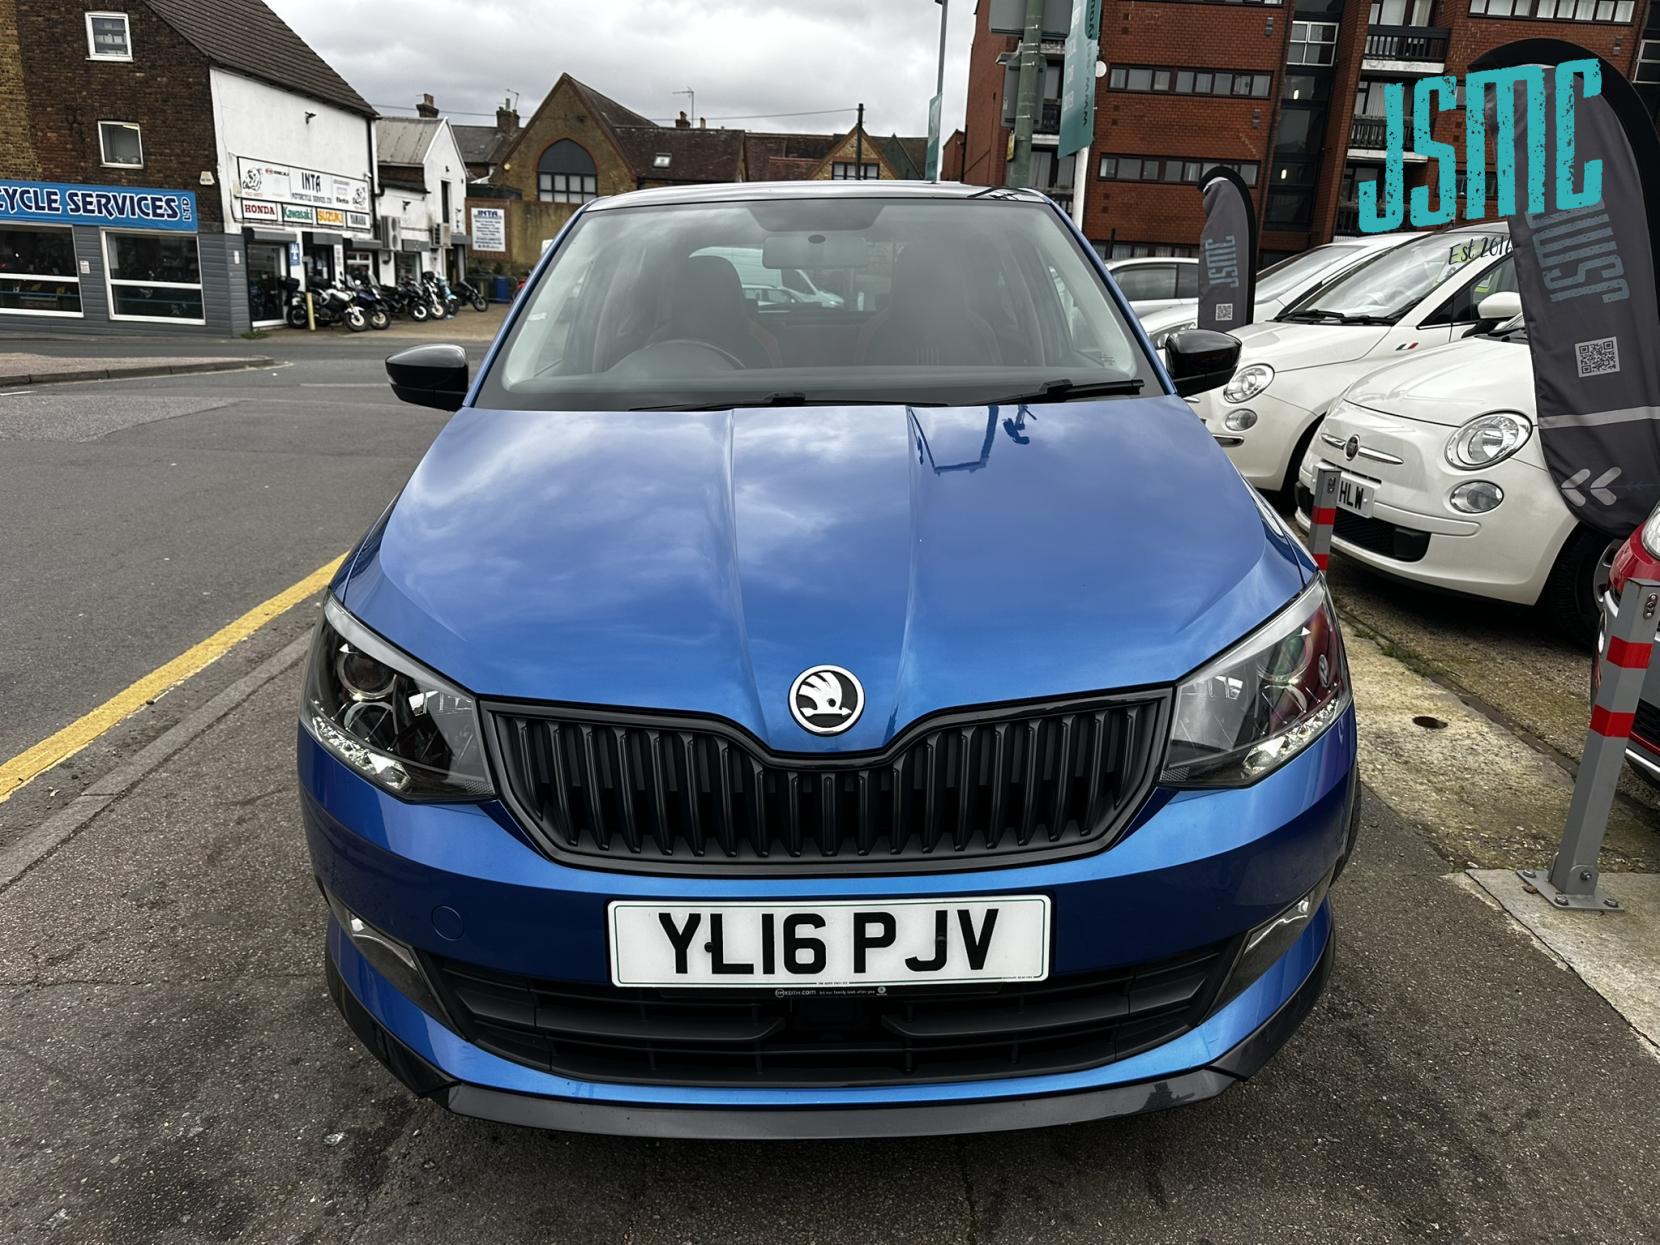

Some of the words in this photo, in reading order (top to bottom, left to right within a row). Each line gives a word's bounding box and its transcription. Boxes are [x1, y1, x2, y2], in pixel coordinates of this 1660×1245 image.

[301, 172, 321, 193] INTA
[0, 186, 63, 214] YCLE
[66, 189, 180, 221] SERVICES
[181, 197, 192, 222] LTD
[244, 204, 276, 216] HONDA
[282, 205, 313, 221] Kawasaki
[317, 209, 344, 223] SUZUKI
[1205, 235, 1239, 288] JSMC
[658, 912, 827, 974] YL16
[853, 908, 999, 974] PJV
